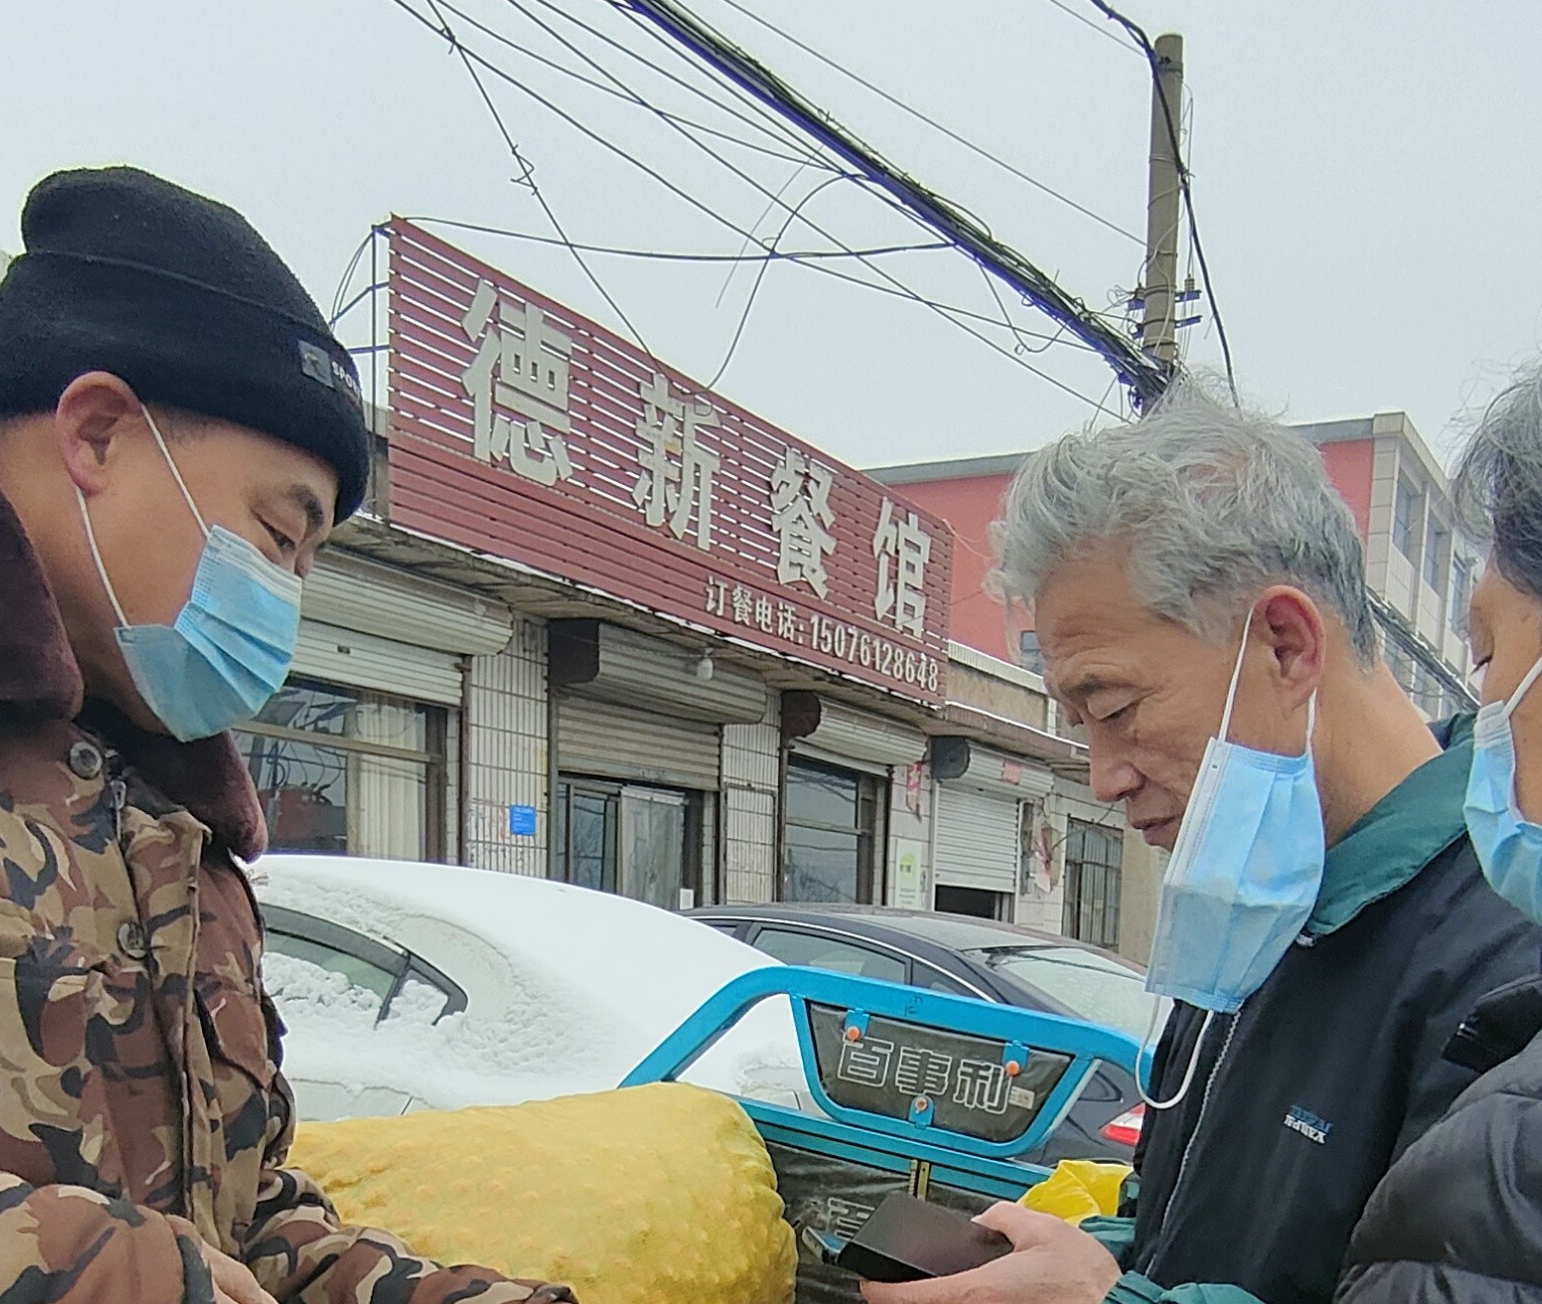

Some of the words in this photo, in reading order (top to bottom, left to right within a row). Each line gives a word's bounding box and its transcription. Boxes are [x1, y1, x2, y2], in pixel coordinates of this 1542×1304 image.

[460, 278, 932, 638] 德新餐馆
[837, 1032, 1012, 1115] 百事利
